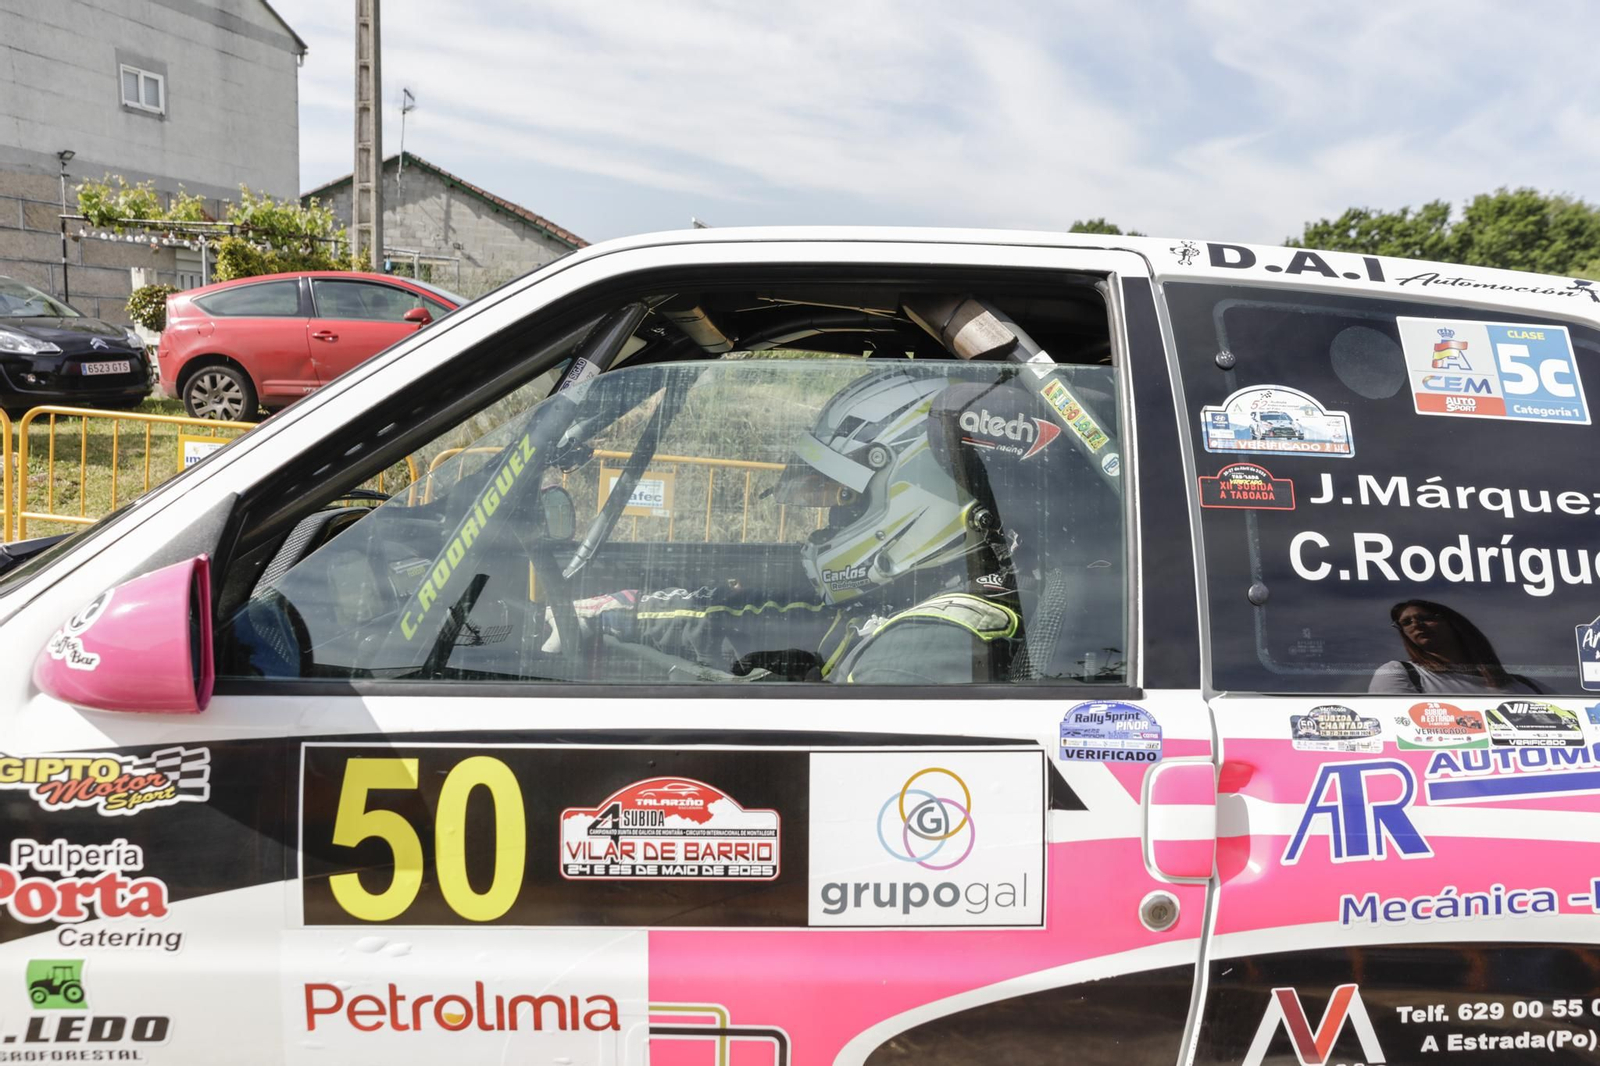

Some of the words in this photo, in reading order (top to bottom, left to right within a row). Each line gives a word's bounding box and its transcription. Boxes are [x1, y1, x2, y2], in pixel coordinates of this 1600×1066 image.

[1205, 243, 1386, 283] D.A.I
[1395, 272, 1577, 298] Automoción
[1507, 330, 1546, 341] CLASE
[87, 362, 111, 374] 6523
[111, 360, 130, 373] GTS
[570, 359, 587, 380] SIGAD
[1496, 343, 1577, 398] 5c
[1422, 375, 1493, 395] CEM
[1446, 397, 1476, 406] AUTO
[1446, 403, 1477, 412] SPORT
[1513, 404, 1570, 418] Categoría
[1572, 408, 1580, 417] 1
[959, 409, 1034, 443] atech
[996, 443, 1024, 456] racing
[1238, 440, 1321, 452] VERIFICADO
[1220, 491, 1227, 500] A
[1230, 491, 1276, 501] TABOADA
[1237, 482, 1274, 491] SUBIDA
[1309, 473, 1600, 518] J.Márque
[400, 433, 536, 641] C.RODRÍGUEZ
[822, 565, 867, 583] Carlos
[1289, 531, 1600, 597] C.Rodrígu
[1318, 714, 1352, 722] SUBIDA
[1503, 703, 1530, 714] VII
[1319, 721, 1369, 730] CHANTADA
[1065, 749, 1157, 762] VERIFICADO
[1429, 742, 1600, 775] AUTOM
[37, 771, 168, 804] Motor
[106, 786, 176, 811] Sport
[623, 810, 665, 827] SUBIDA
[916, 806, 943, 834] G
[328, 755, 527, 922] 50
[706, 829, 740, 837] INTERNACIONAL
[17, 843, 140, 872] Pulpería
[566, 842, 635, 860] VILAR
[644, 842, 676, 861] DE
[684, 842, 773, 861] BARRIO
[567, 865, 591, 875] 24
[594, 865, 606, 875] E
[609, 865, 632, 875] 25
[635, 865, 658, 876] DE
[661, 865, 699, 876] MAIO
[702, 865, 725, 876] DE
[728, 865, 774, 876] 2025
[820, 873, 1028, 916] grupogal
[1341, 885, 1556, 925] Mecánica
[58, 927, 183, 951] Catering
[303, 980, 622, 1033] Petrolimia
[1396, 1004, 1450, 1024] Telf.
[1457, 1002, 1505, 1021] 629
[1512, 1000, 1544, 1019] 00
[1551, 999, 1584, 1018] 55
[1420, 1035, 1440, 1053] A
[1447, 1028, 1598, 1053] Estrada(Po)
